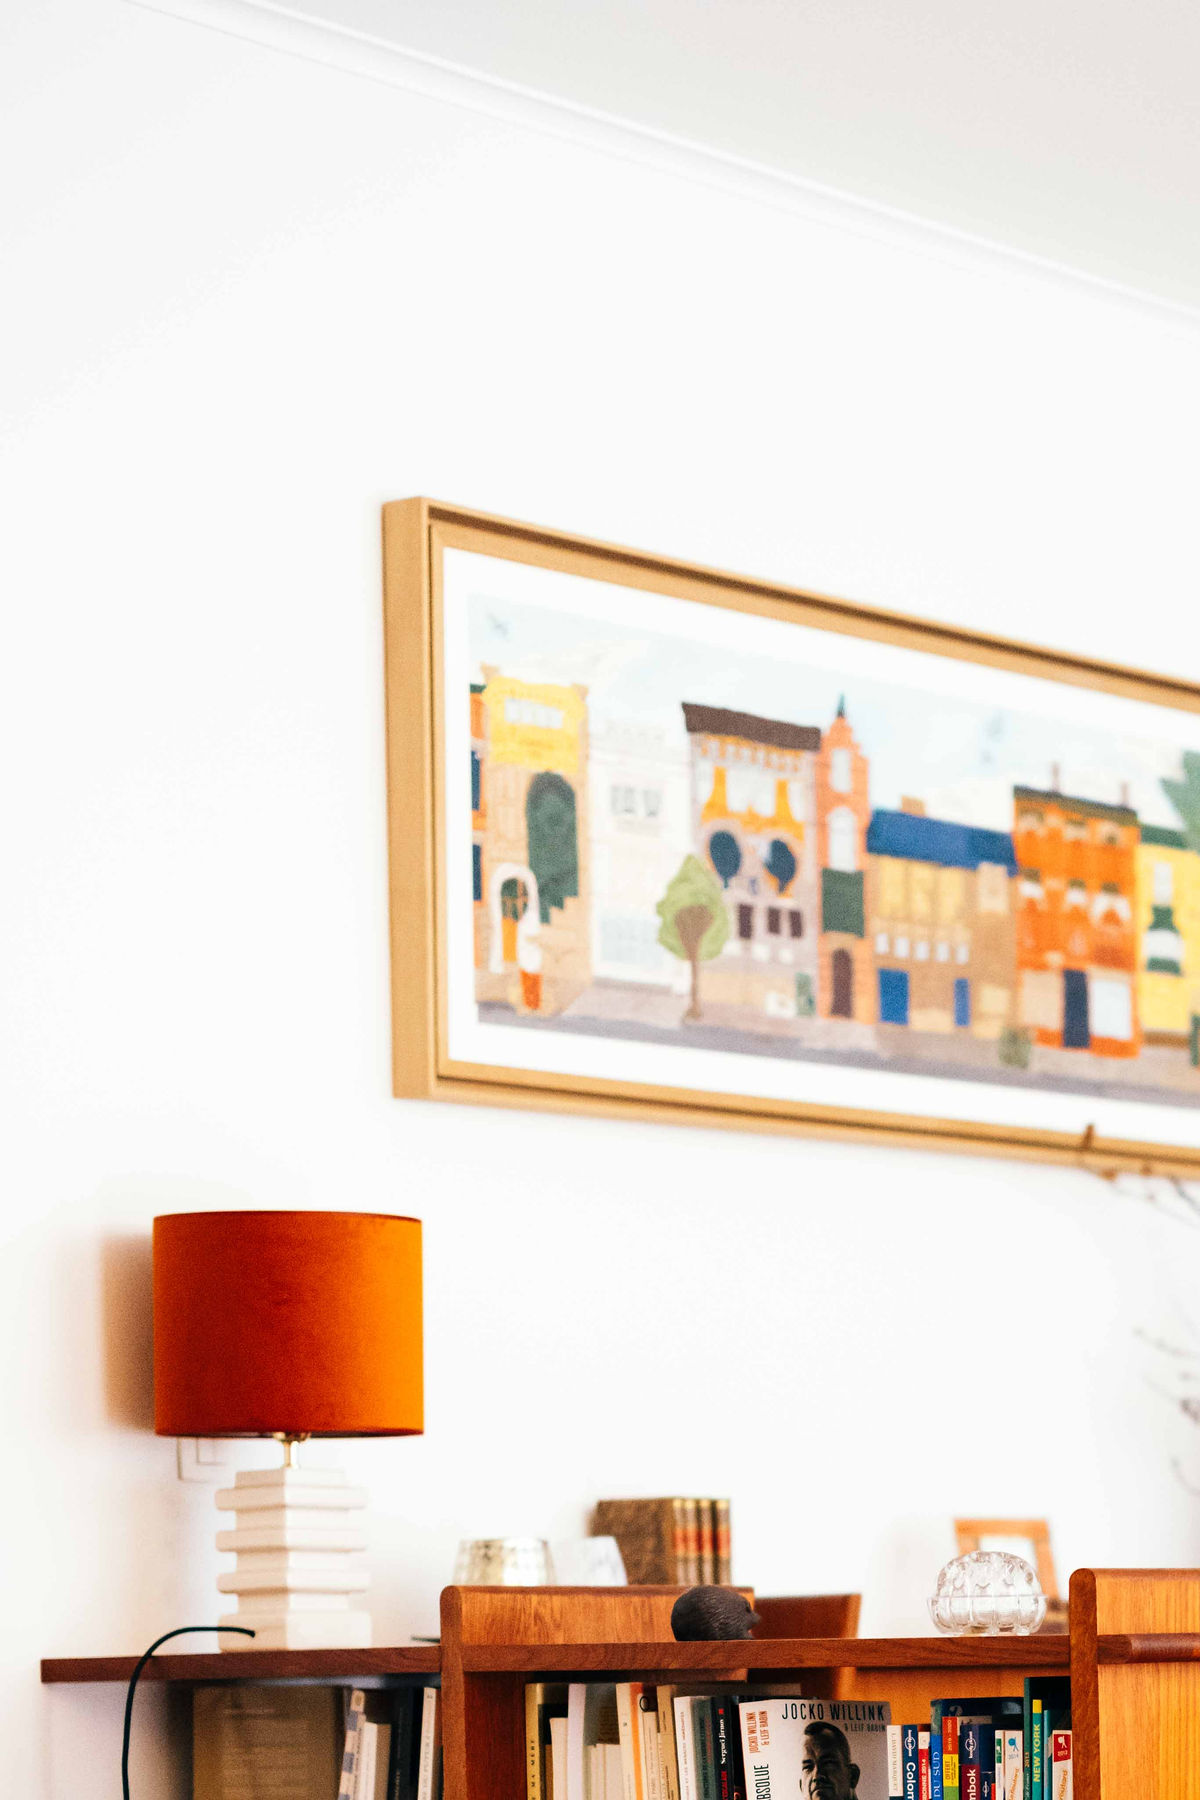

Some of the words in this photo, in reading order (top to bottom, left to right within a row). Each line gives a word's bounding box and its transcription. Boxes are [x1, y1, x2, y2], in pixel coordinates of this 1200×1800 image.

[781, 1702, 824, 1720] JOCKO
[830, 1703, 885, 1721] WILLINK
[746, 1711, 757, 1735] WILLINK
[748, 1734, 760, 1753] JOCKO
[1033, 1756, 1041, 1783] NEW
[933, 1779, 941, 1797] DU
